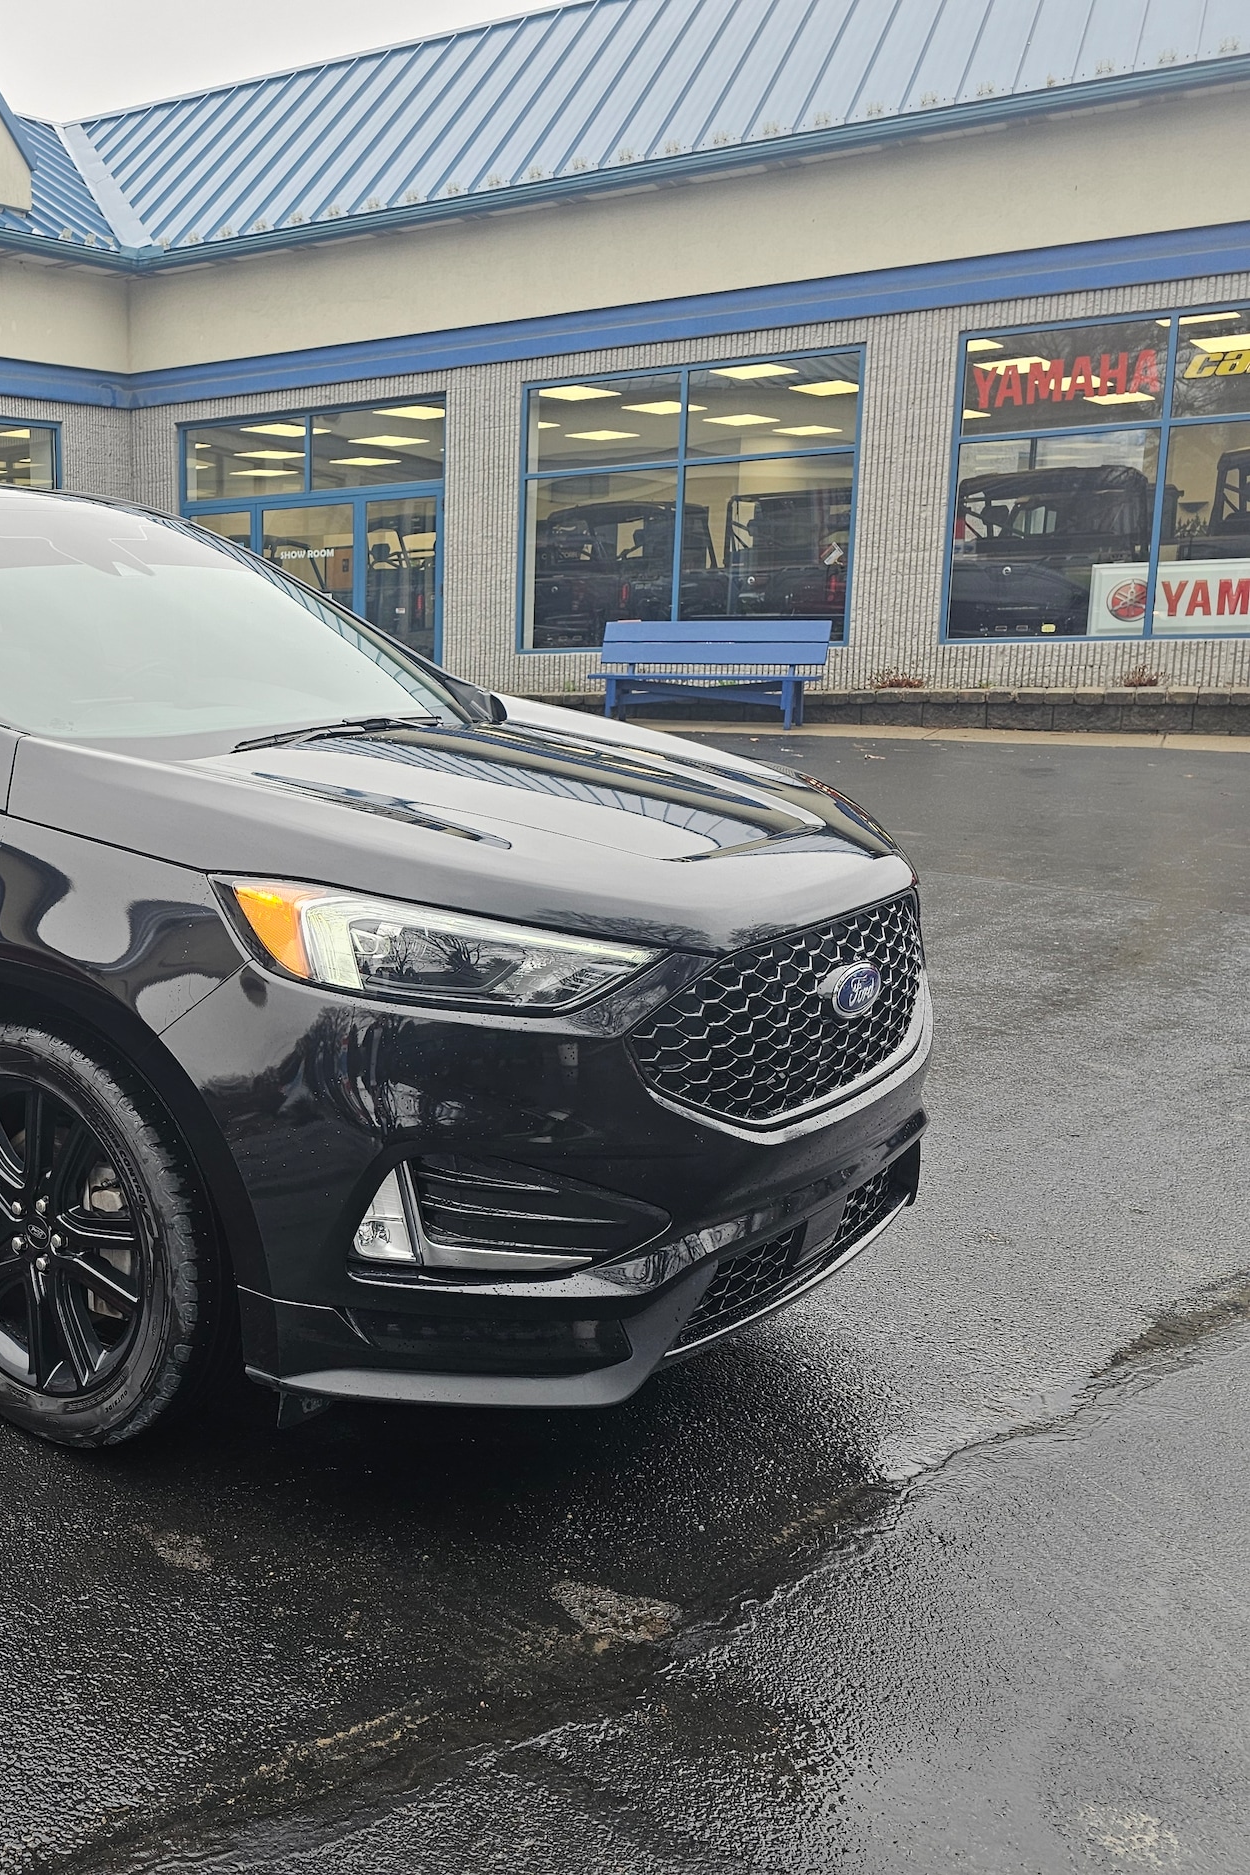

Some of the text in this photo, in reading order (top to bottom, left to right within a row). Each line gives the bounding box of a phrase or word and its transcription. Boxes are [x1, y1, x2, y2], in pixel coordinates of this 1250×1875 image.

[972, 349, 1160, 409] YAMAHA
[1183, 350, 1250, 379] ca
[280, 549, 334, 559] SHOW ROOM
[849, 974, 875, 1007] Ford
